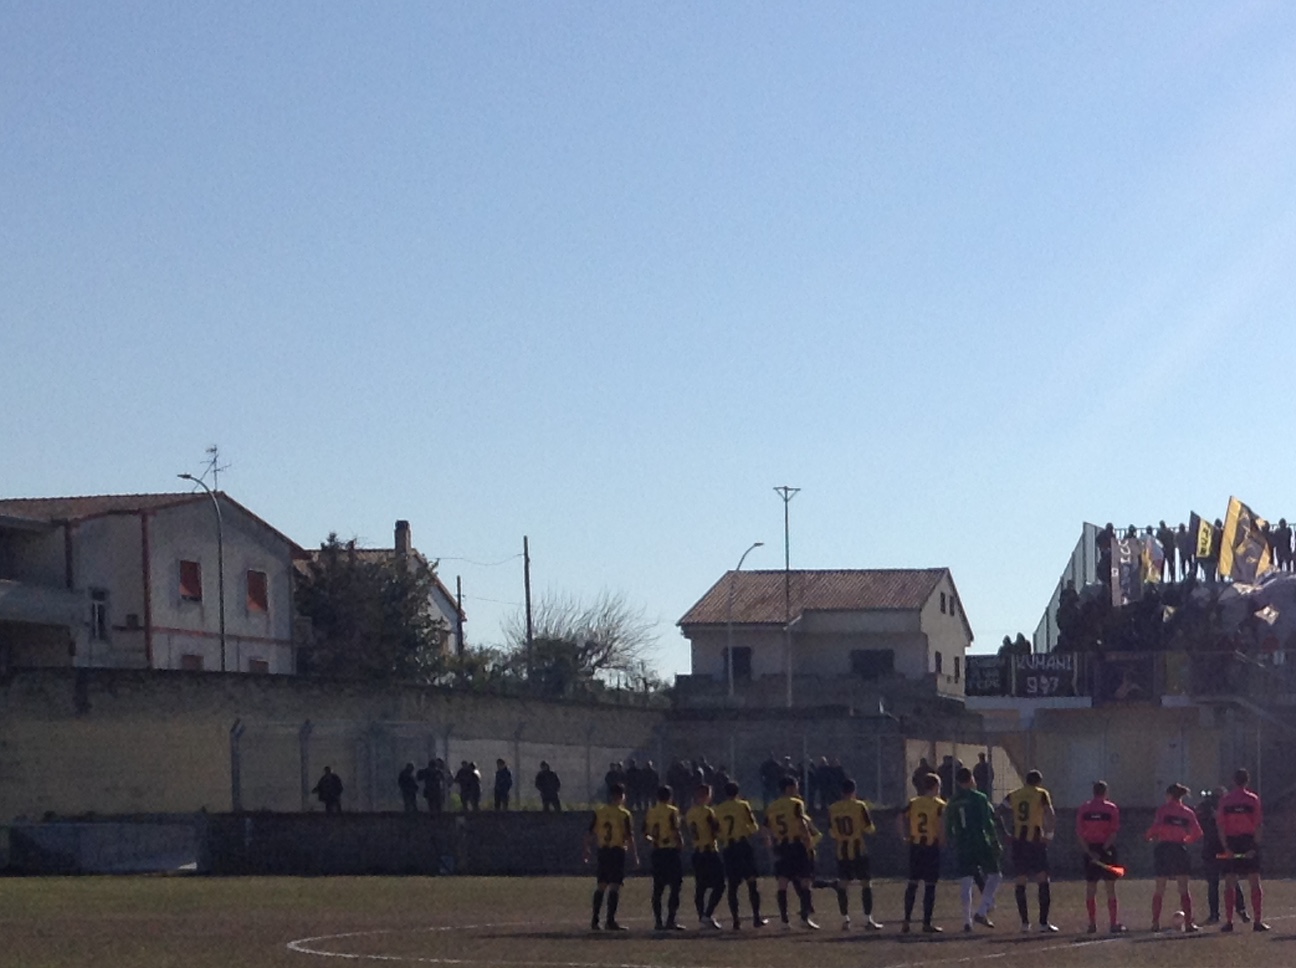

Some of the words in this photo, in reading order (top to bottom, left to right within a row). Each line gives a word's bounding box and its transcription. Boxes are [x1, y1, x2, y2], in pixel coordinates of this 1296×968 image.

[959, 806, 967, 828] 1
[1018, 800, 1030, 821] 9
[723, 815, 735, 835] 7
[775, 814, 788, 835] 5
[835, 815, 854, 837] 10
[917, 812, 928, 833] 2
